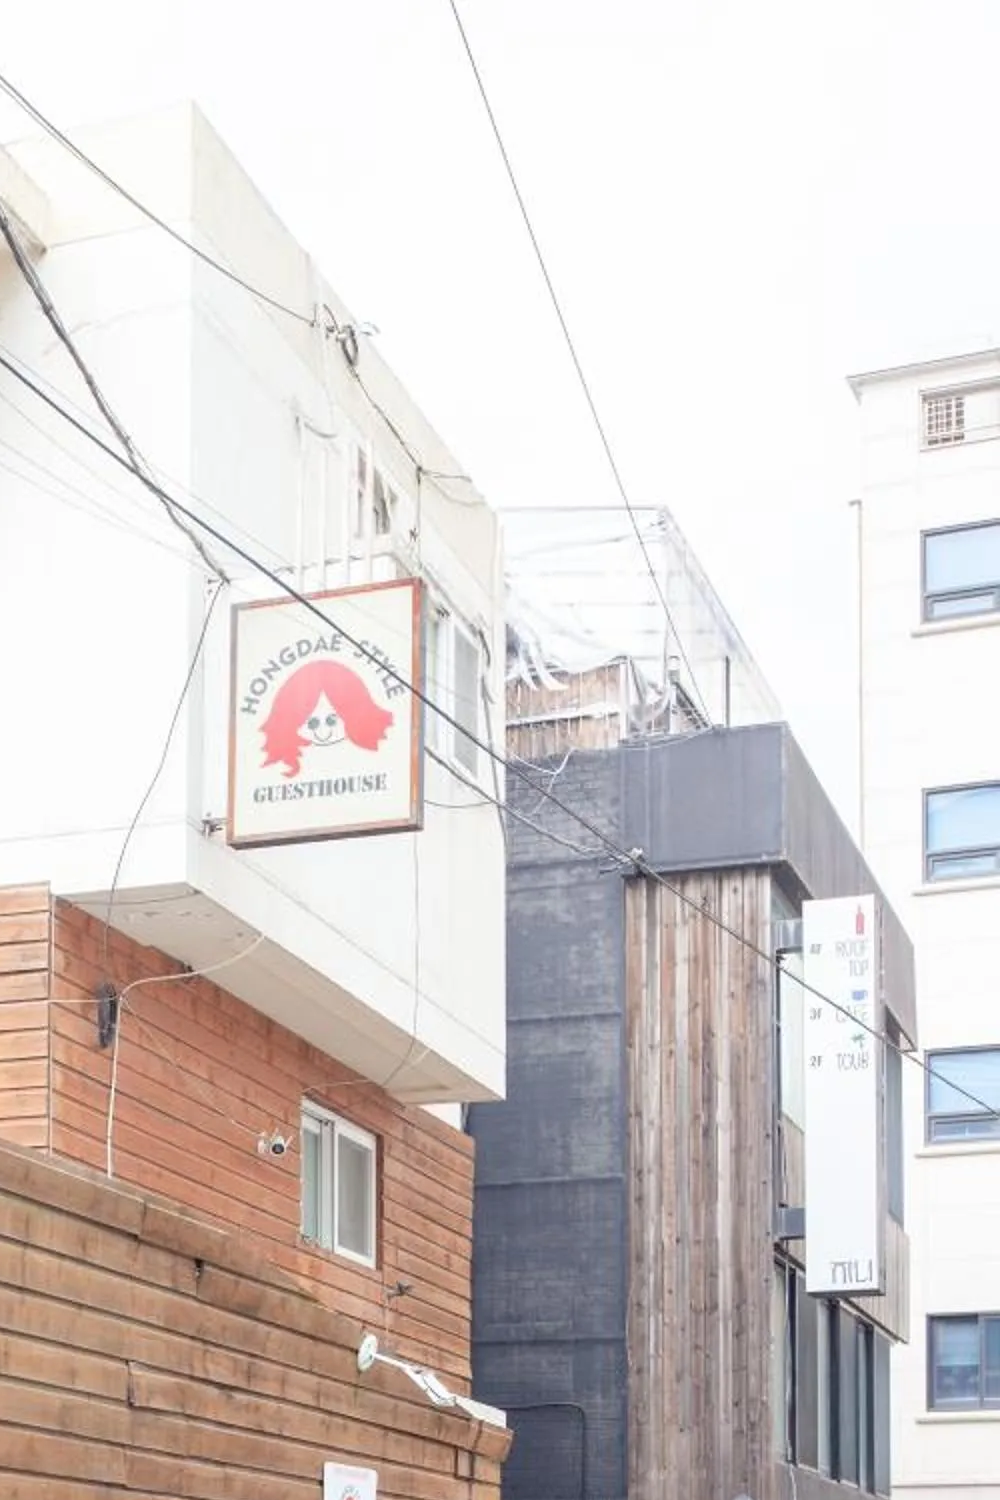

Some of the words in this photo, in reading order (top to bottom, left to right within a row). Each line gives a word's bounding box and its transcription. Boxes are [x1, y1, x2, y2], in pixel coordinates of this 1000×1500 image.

[241, 633, 343, 715] HONGDAE
[353, 640, 405, 700] STYLE
[253, 773, 387, 803] GUESTHOUSE
[849, 959, 869, 977] TOP
[810, 1055, 823, 1067] 2F
